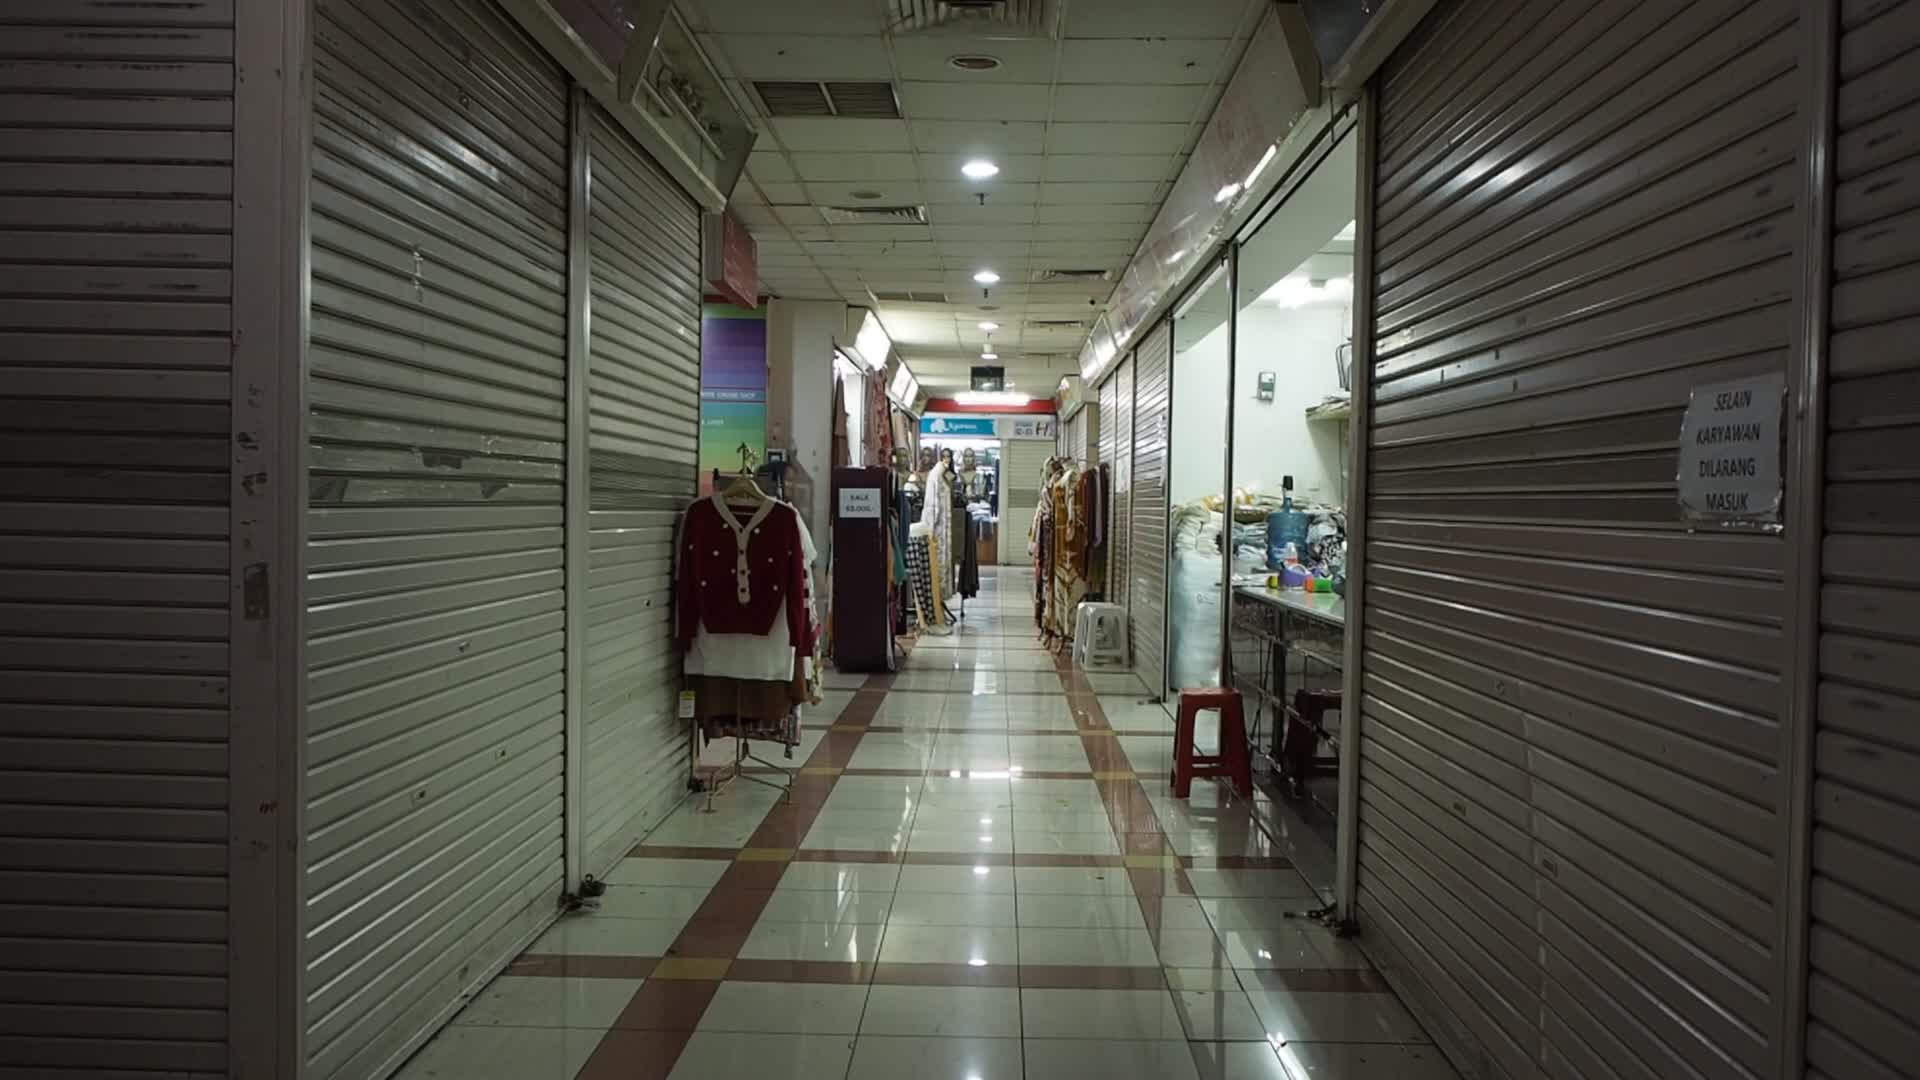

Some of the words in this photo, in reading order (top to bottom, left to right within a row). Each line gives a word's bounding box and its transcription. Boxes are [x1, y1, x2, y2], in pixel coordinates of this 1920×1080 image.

[1714, 389, 1752, 411] SELAIN
[1696, 423, 1760, 446] KARYAWAN
[1699, 458, 1755, 478] DILARANG
[1705, 492, 1749, 511] MASUK
